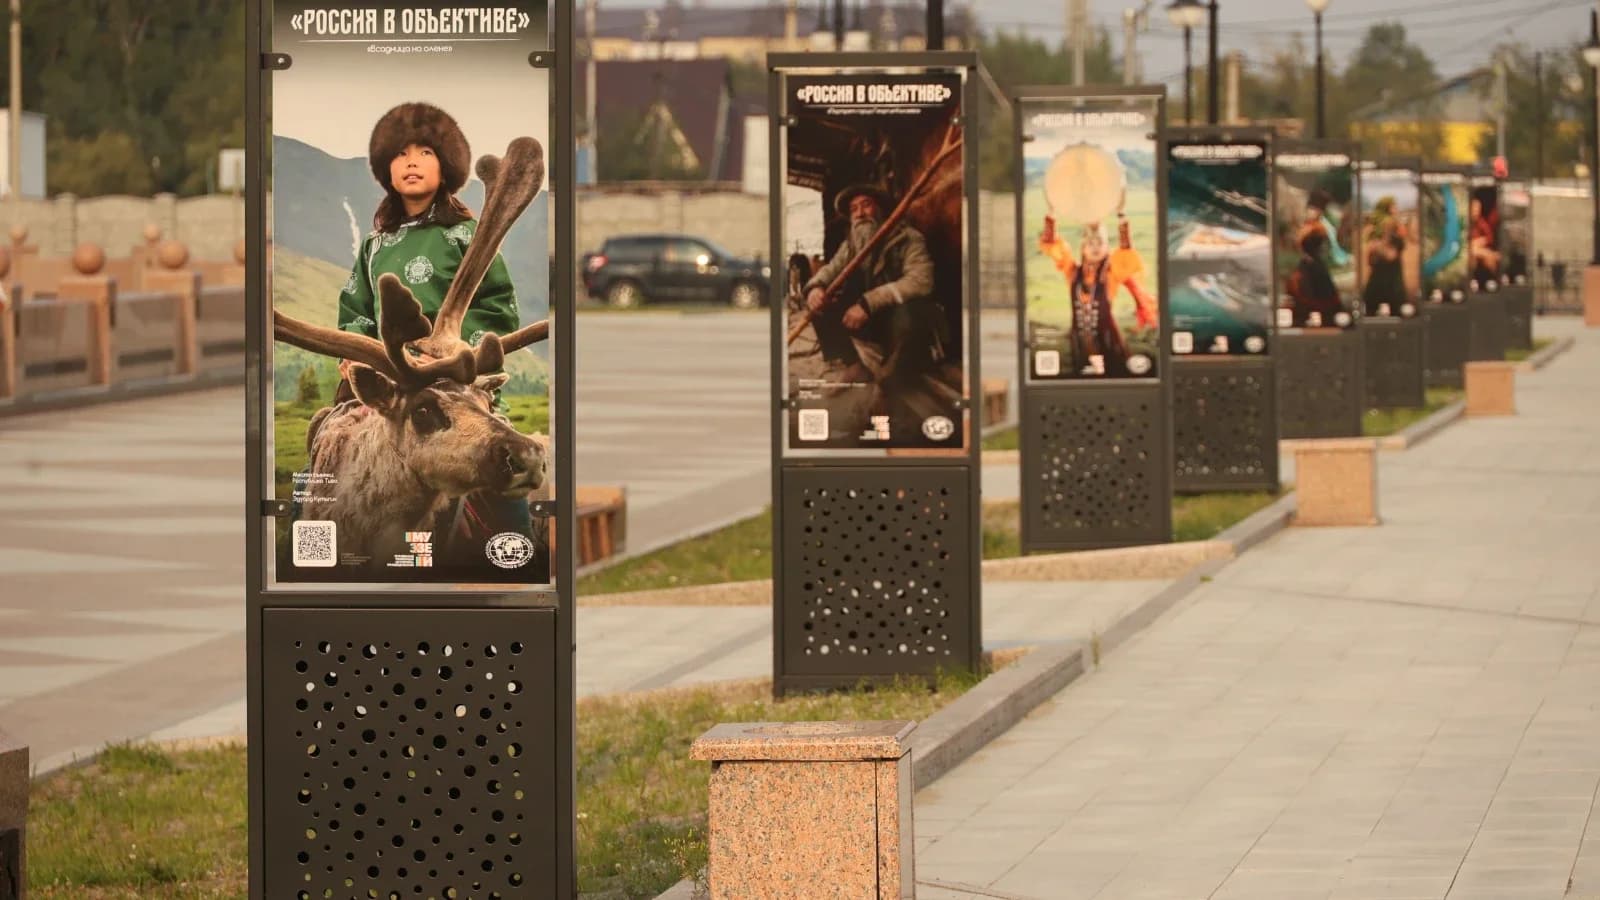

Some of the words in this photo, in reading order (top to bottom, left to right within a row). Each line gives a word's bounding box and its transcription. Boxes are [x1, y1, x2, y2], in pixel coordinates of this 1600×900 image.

[290, 8, 377, 34] «РОССИЯ
[384, 8, 396, 34] В
[402, 8, 530, 34] ОБЪЕКТИВЕ»
[796, 84, 854, 103] «РОССИЯ
